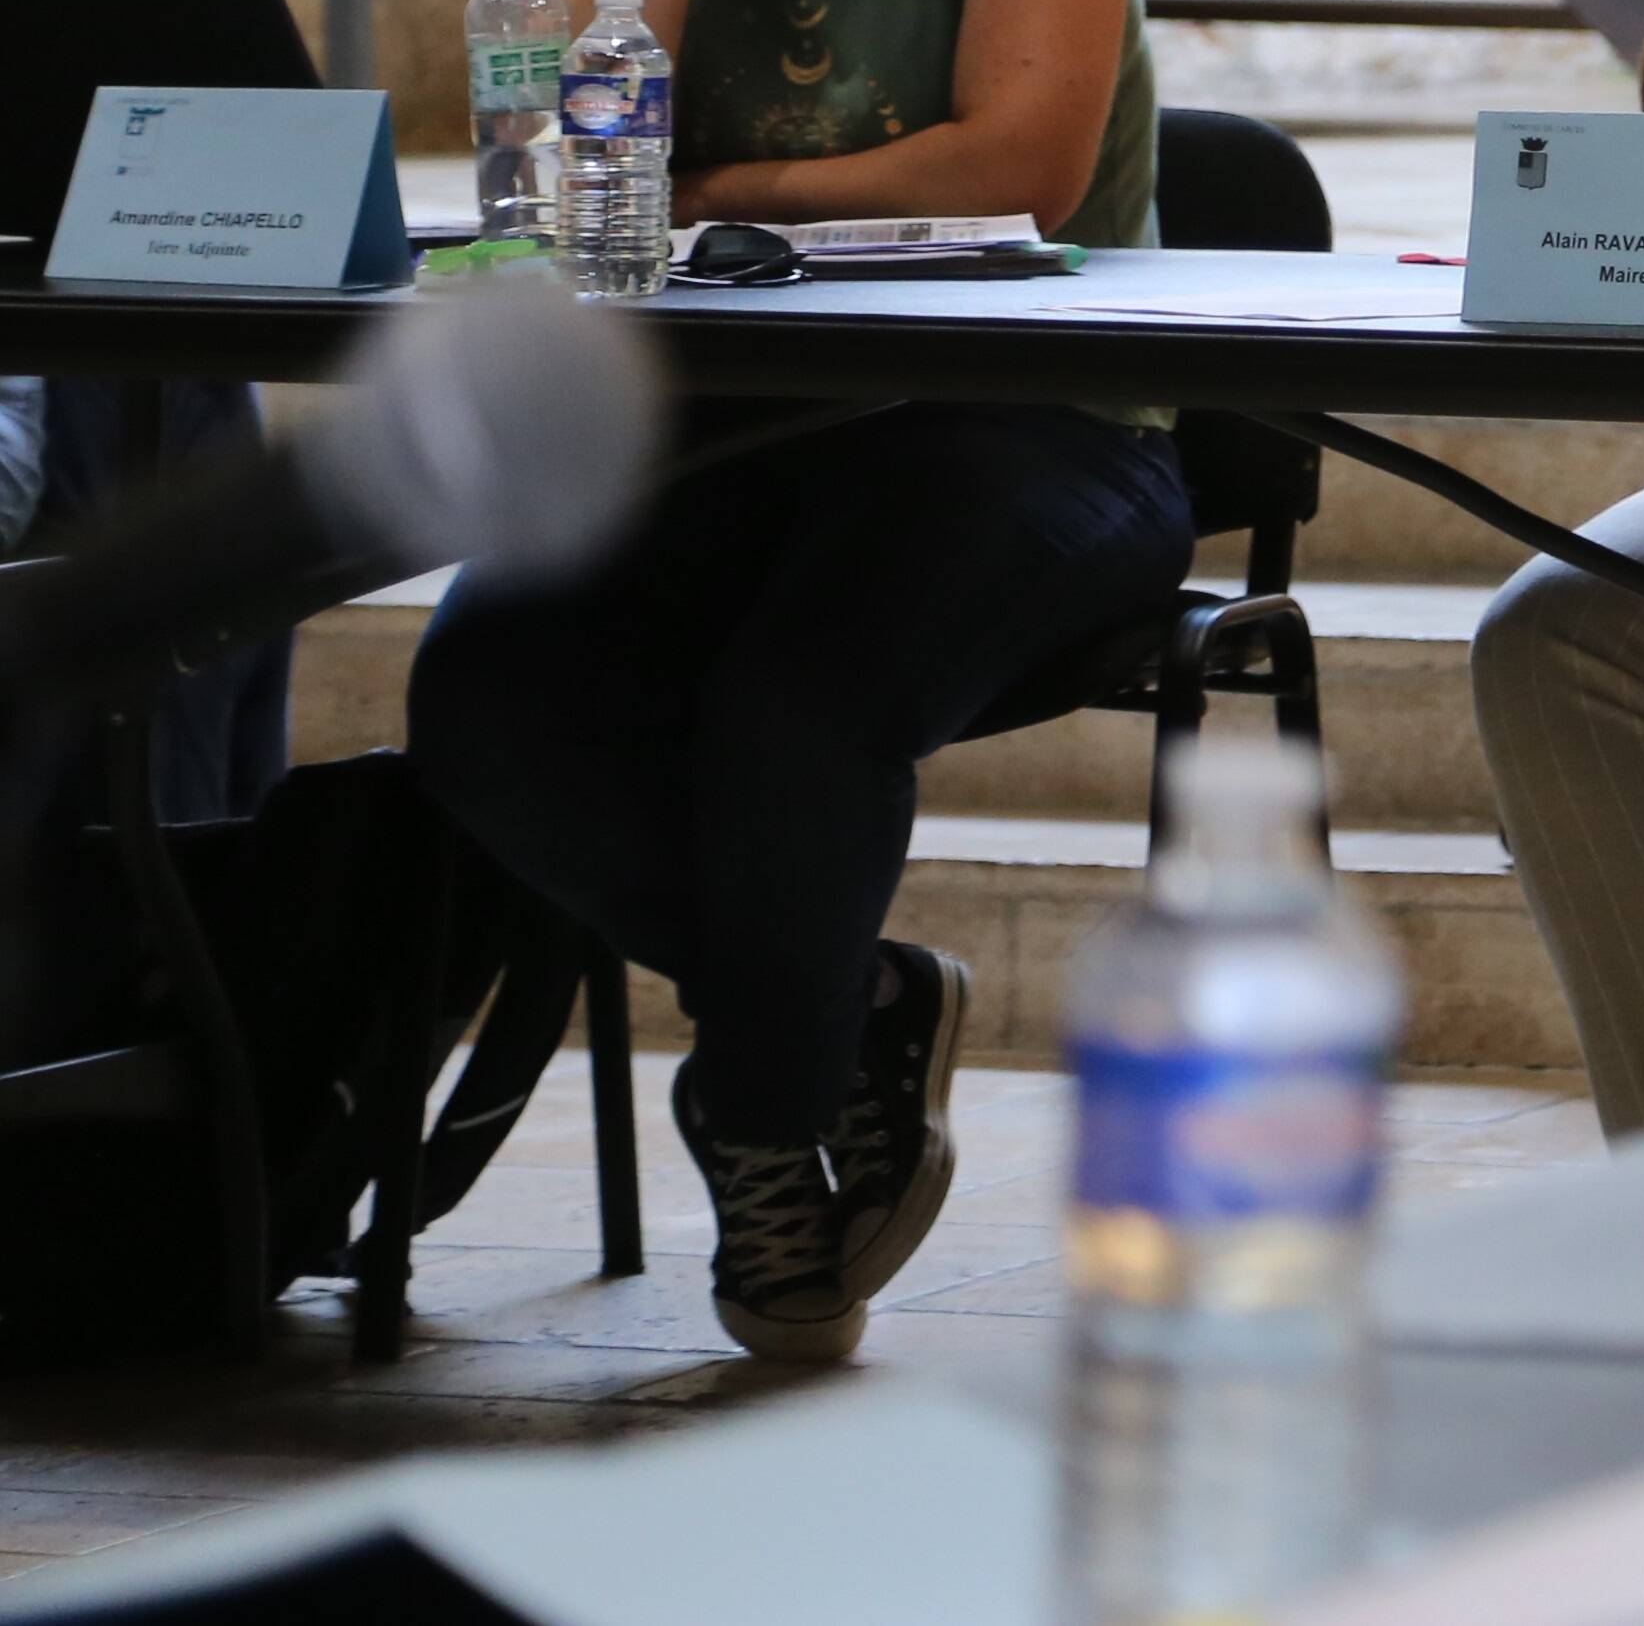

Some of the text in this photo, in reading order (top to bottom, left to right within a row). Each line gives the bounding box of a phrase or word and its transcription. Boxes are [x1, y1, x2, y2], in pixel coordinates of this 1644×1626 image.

[110, 210, 303, 229] Amandine CHIAPELLO
[187, 241, 250, 259] Adjointe
[1541, 231, 1588, 250] Alain
